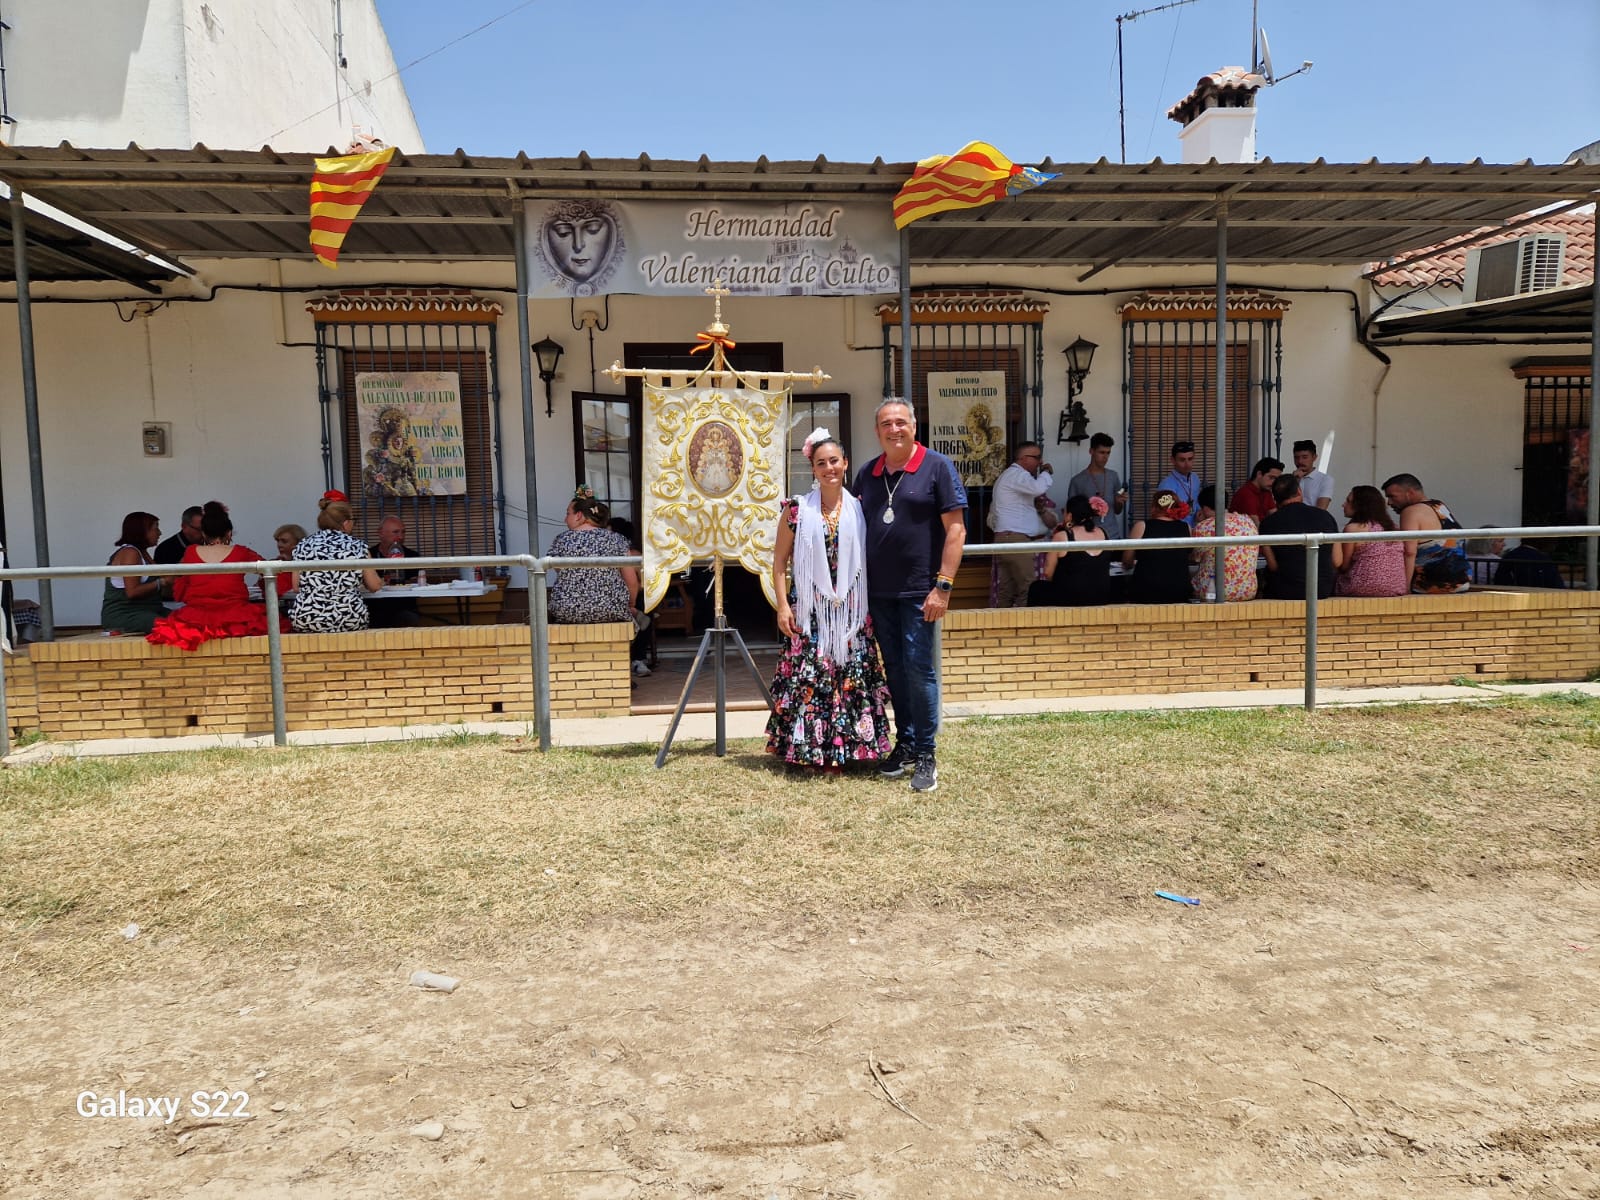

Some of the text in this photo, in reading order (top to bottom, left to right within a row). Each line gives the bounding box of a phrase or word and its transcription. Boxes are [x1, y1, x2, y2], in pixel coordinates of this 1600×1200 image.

[687, 208, 840, 238] Hermandad
[641, 254, 891, 287] Valenciana de Culto
[362, 380, 403, 389] HERMANDAD
[361, 391, 411, 404] VALENCIANA
[413, 391, 426, 403] DE
[431, 445, 463, 458] VIRGEN
[417, 465, 433, 479] DEL
